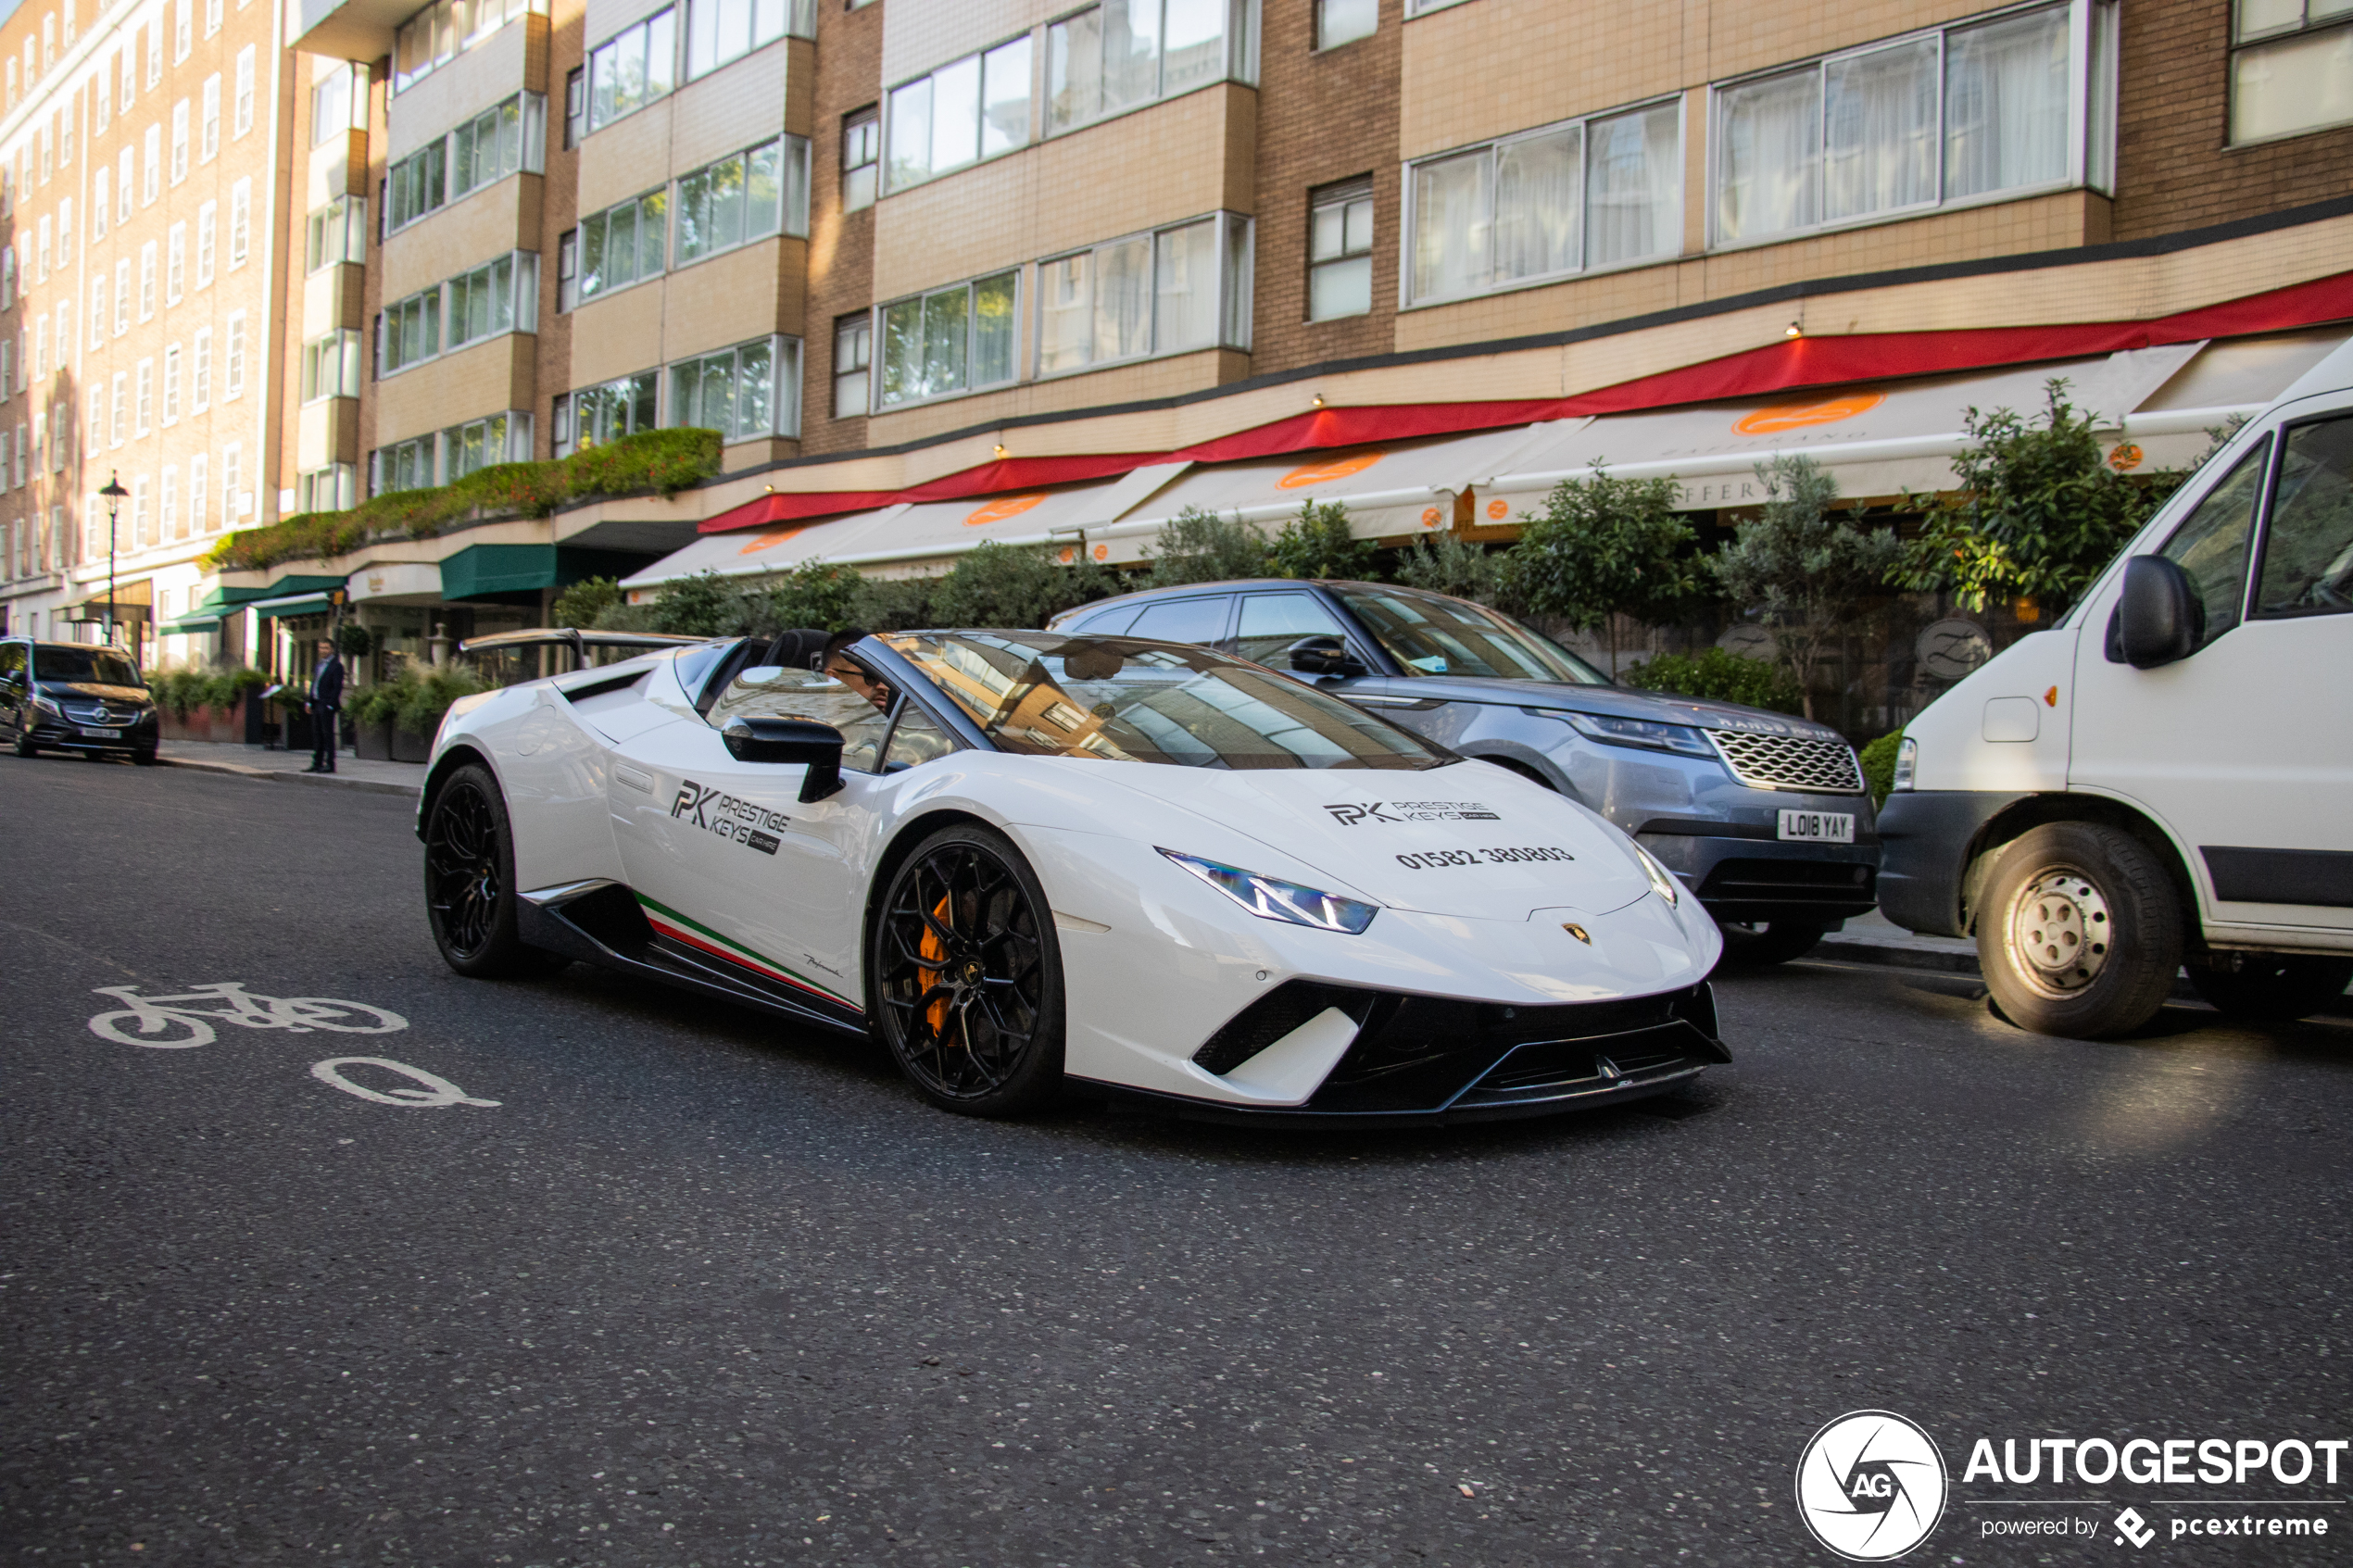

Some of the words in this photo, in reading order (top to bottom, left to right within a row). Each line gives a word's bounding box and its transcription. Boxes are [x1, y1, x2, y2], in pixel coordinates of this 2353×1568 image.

[718, 795, 791, 834] PRESTIGE
[1391, 801, 1490, 811] PRESTIGE
[1403, 811, 1462, 821] KEYS
[709, 815, 751, 844] KEYS
[749, 834, 764, 846] CAR
[762, 838, 778, 850] HIRE
[1788, 814, 1819, 836] LO18
[1824, 816, 1847, 837] YAY
[1395, 849, 1484, 870] 01582
[1478, 847, 1575, 863] 380803
